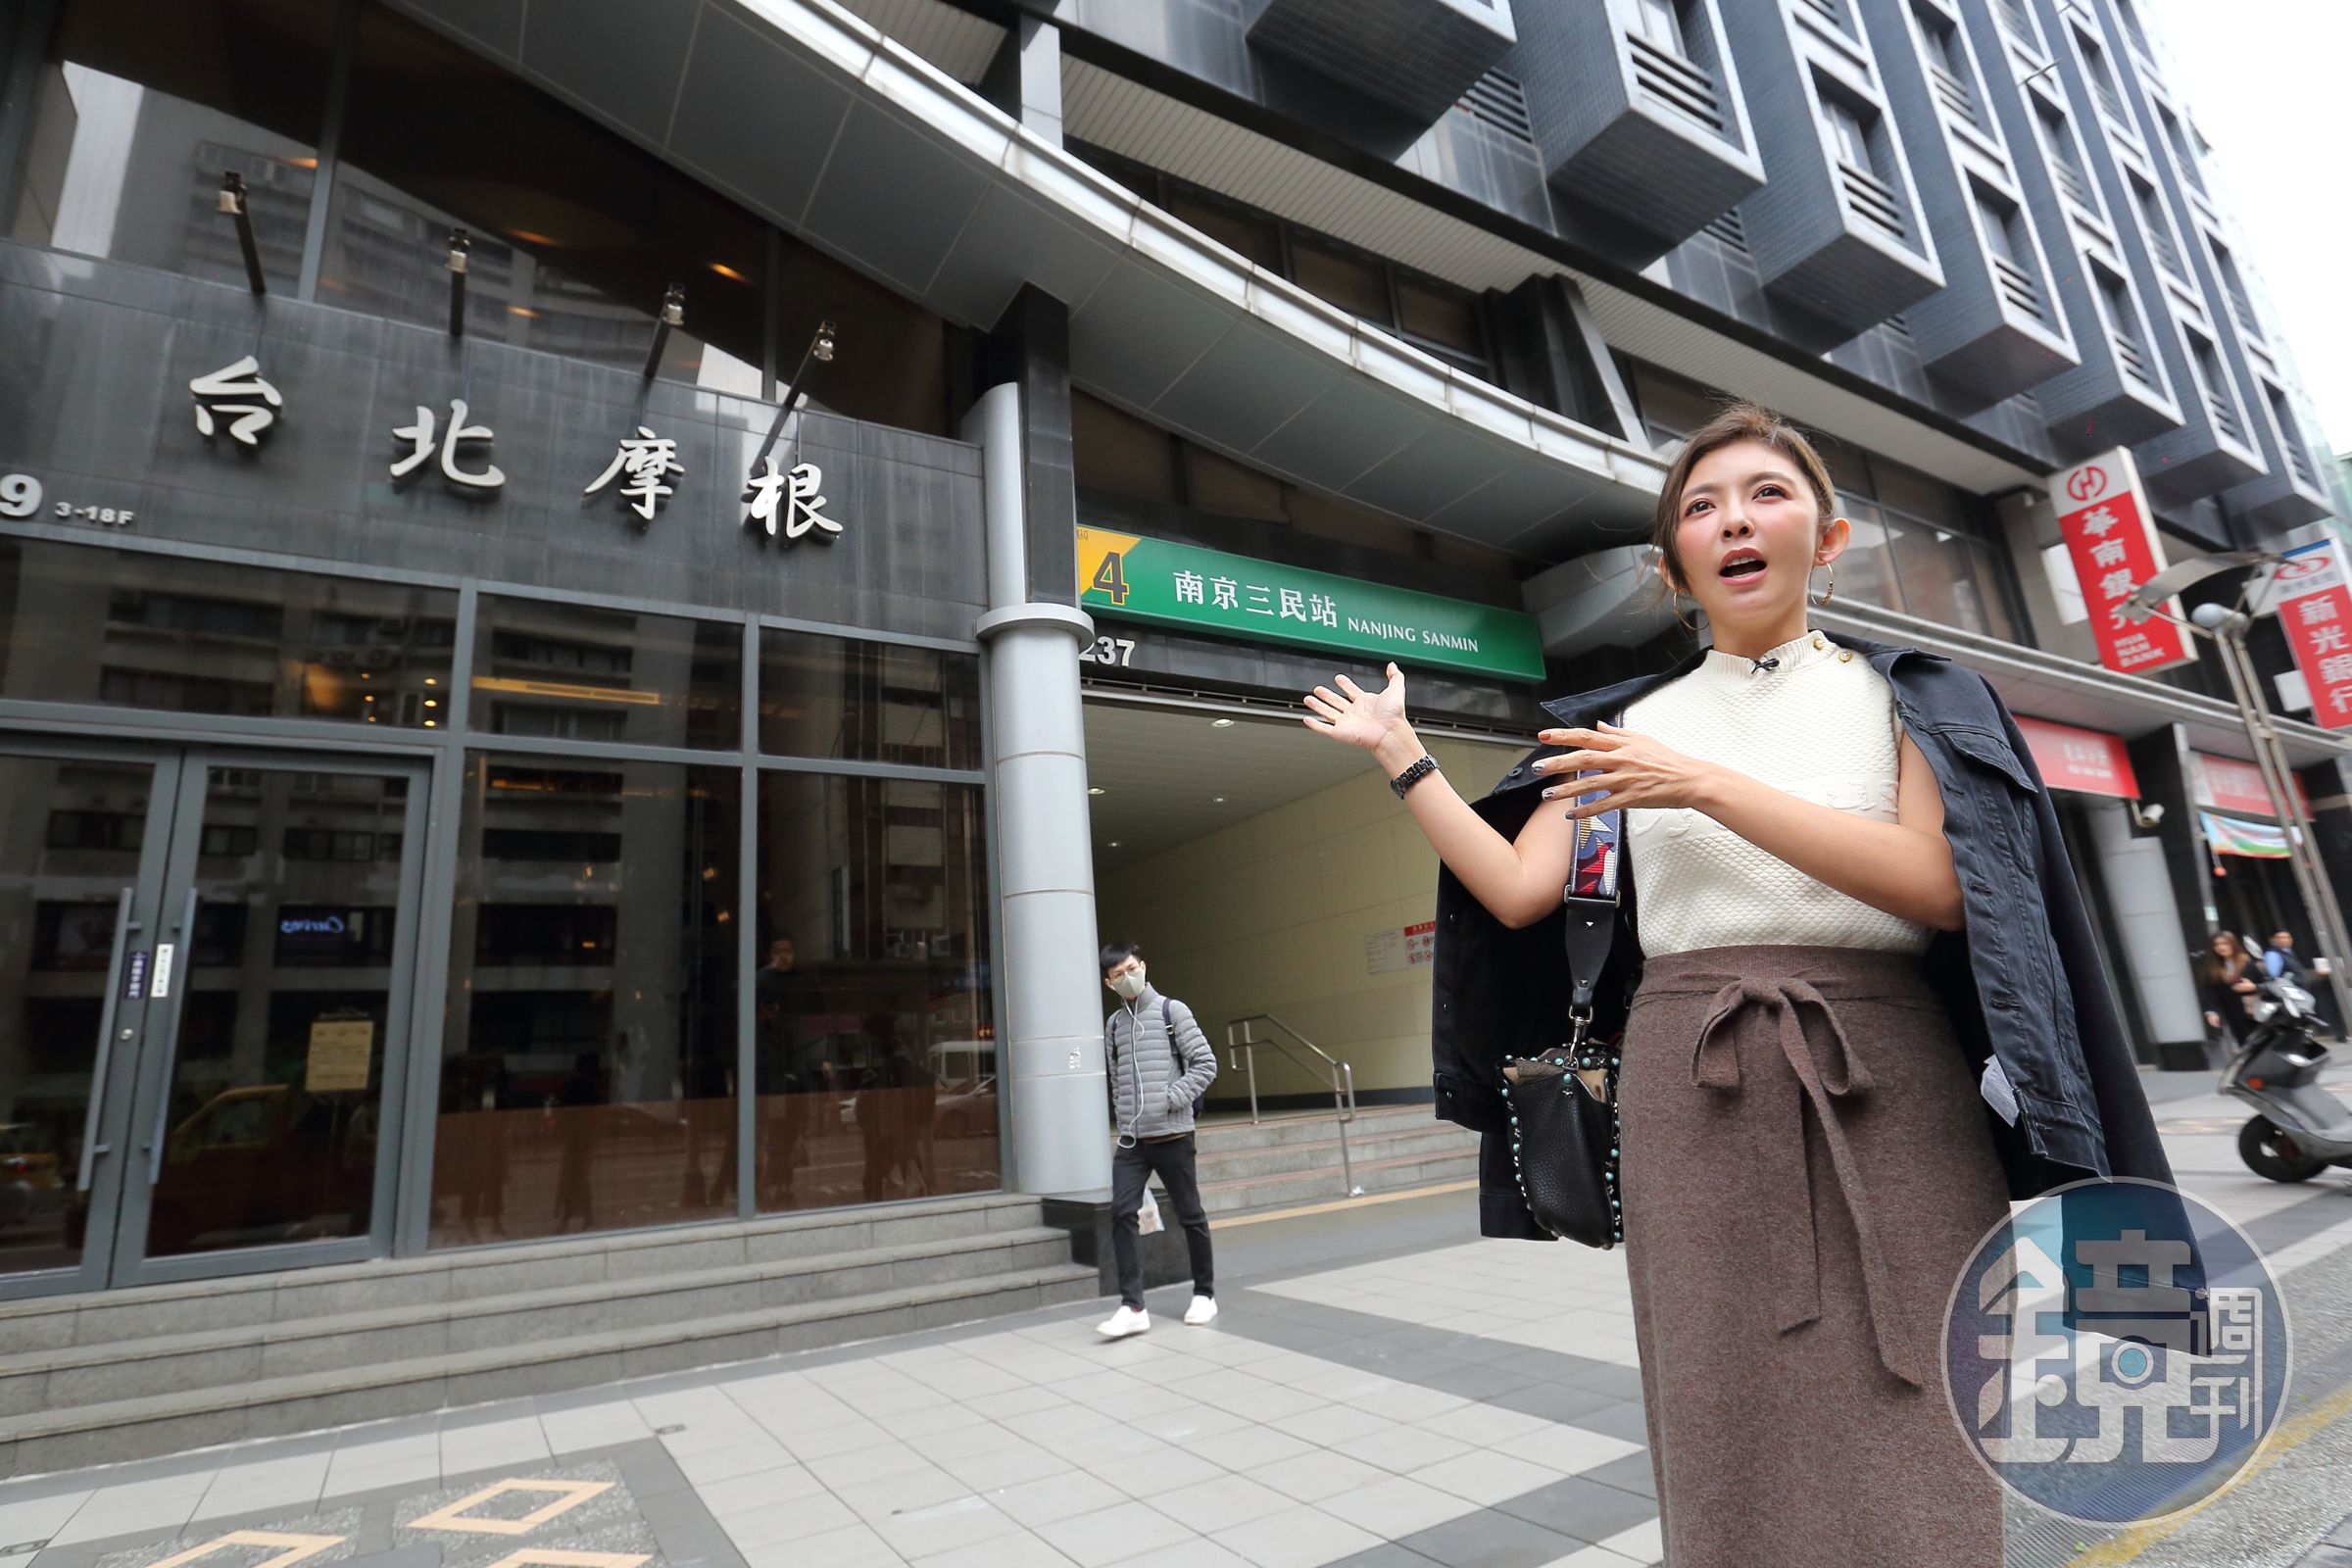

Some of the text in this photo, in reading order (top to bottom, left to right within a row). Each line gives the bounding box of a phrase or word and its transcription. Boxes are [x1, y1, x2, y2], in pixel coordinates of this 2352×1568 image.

[189, 355, 844, 538] 台北摩根
[55, 501, 135, 525] 3-18F
[1093, 551, 1130, 606] 4
[1173, 570, 1479, 653] 南京三民站 NANJING SANMIN
